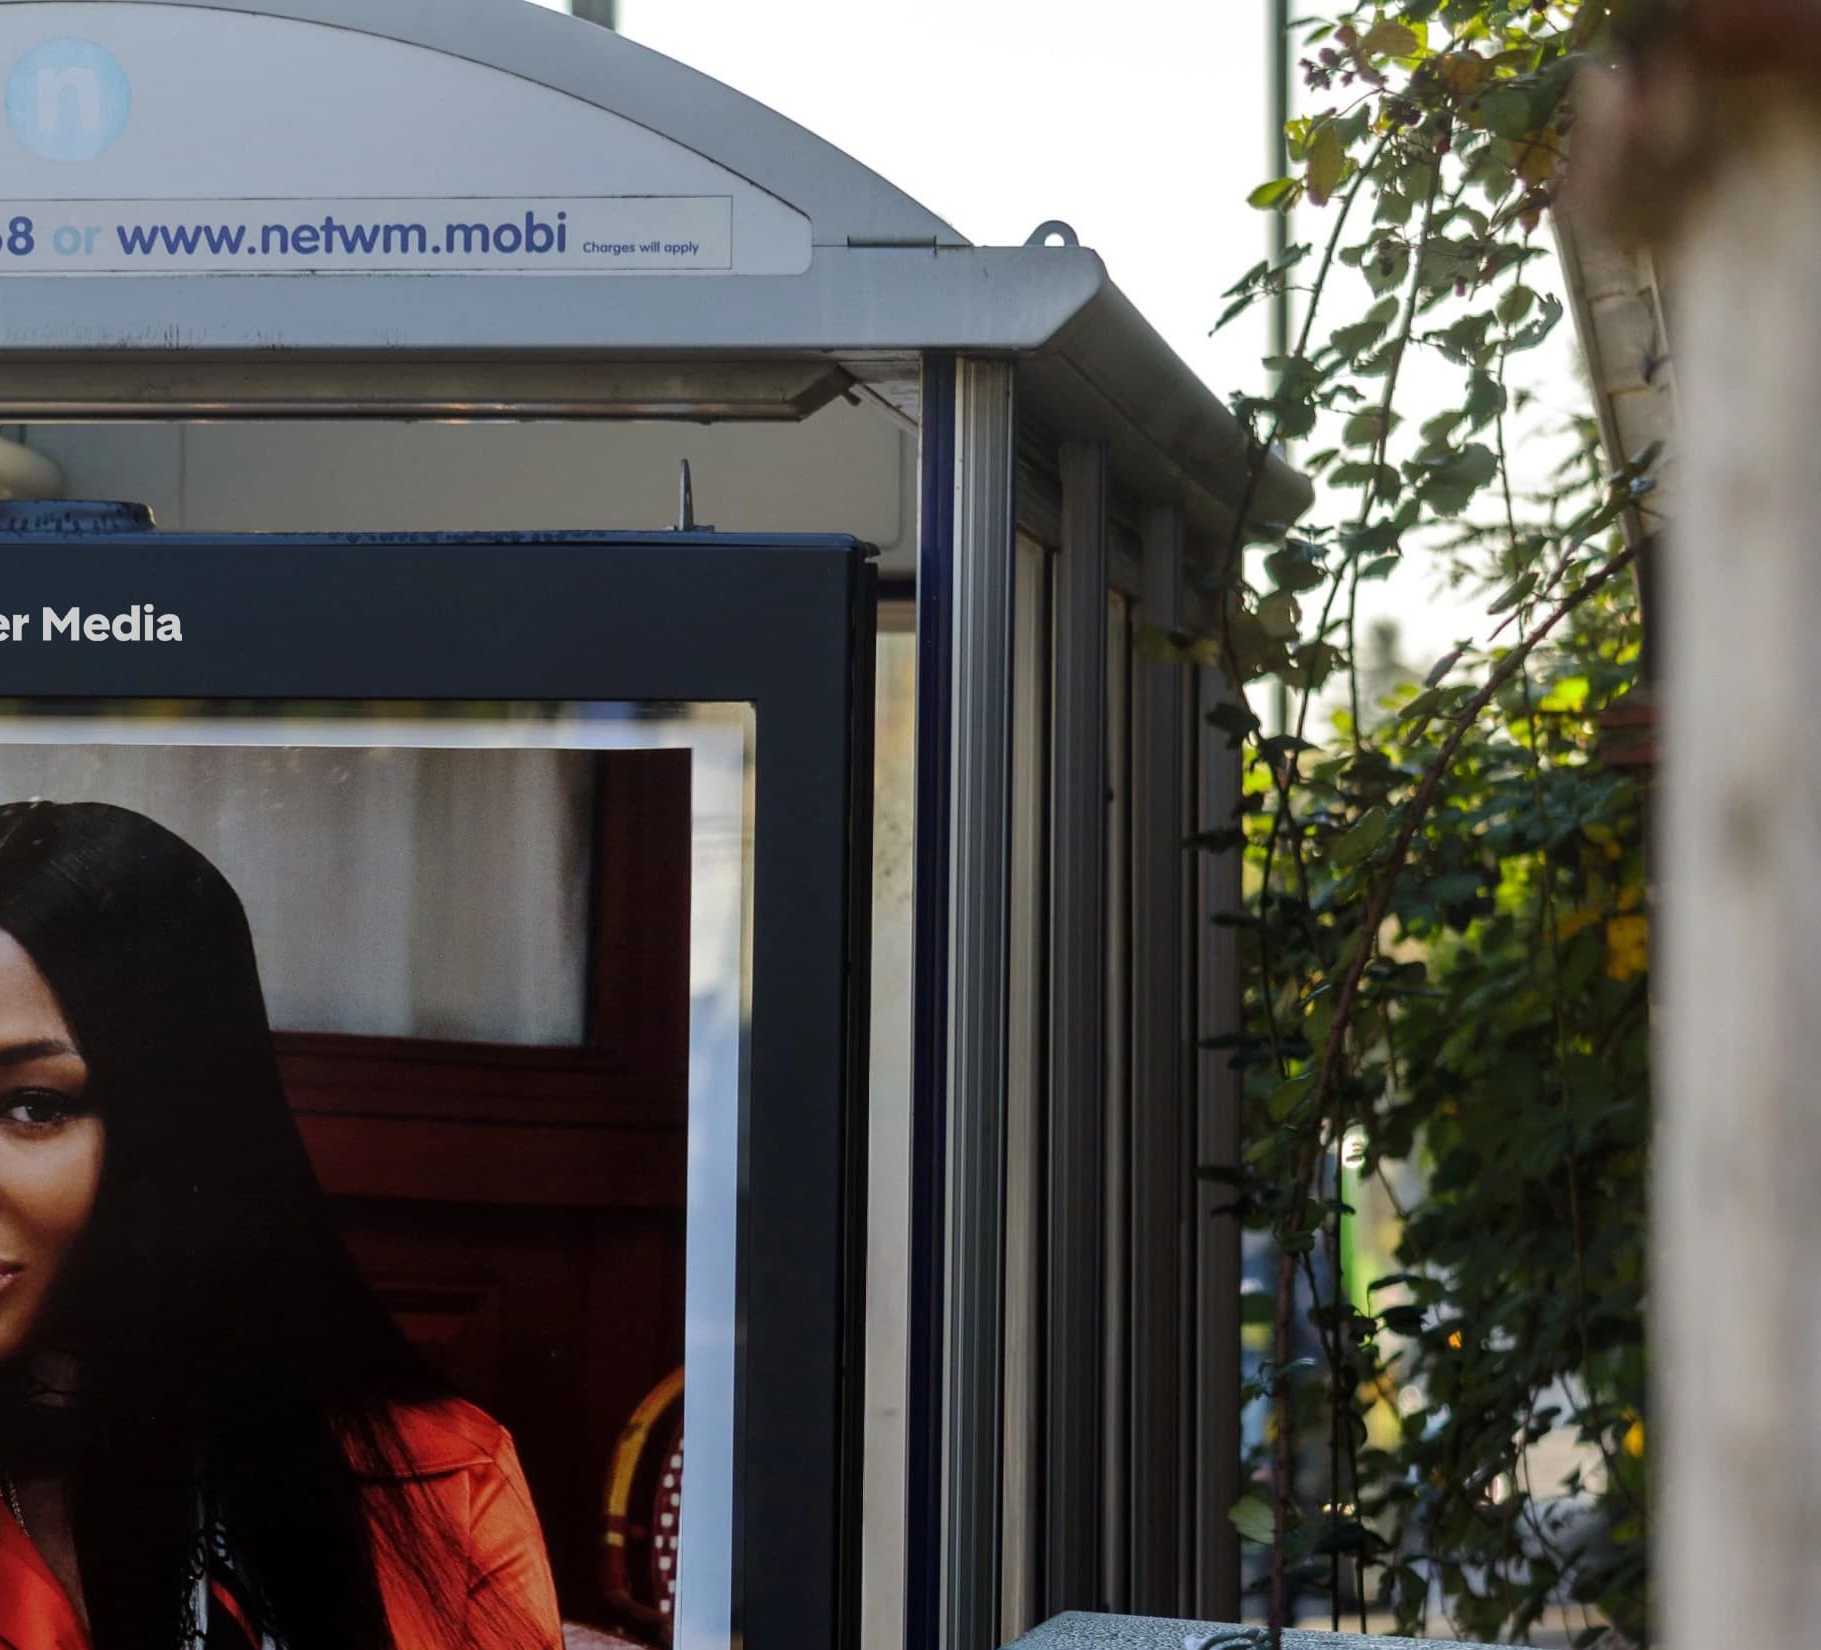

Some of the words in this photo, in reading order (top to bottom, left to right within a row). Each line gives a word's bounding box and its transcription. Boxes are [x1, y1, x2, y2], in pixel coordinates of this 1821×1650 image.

[52, 225, 102, 256] or
[117, 211, 567, 256] www.netwm.mobi
[583, 241, 635, 256] Charges
[639, 241, 660, 253] will
[664, 241, 699, 256] apply
[42, 603, 183, 642] Media
